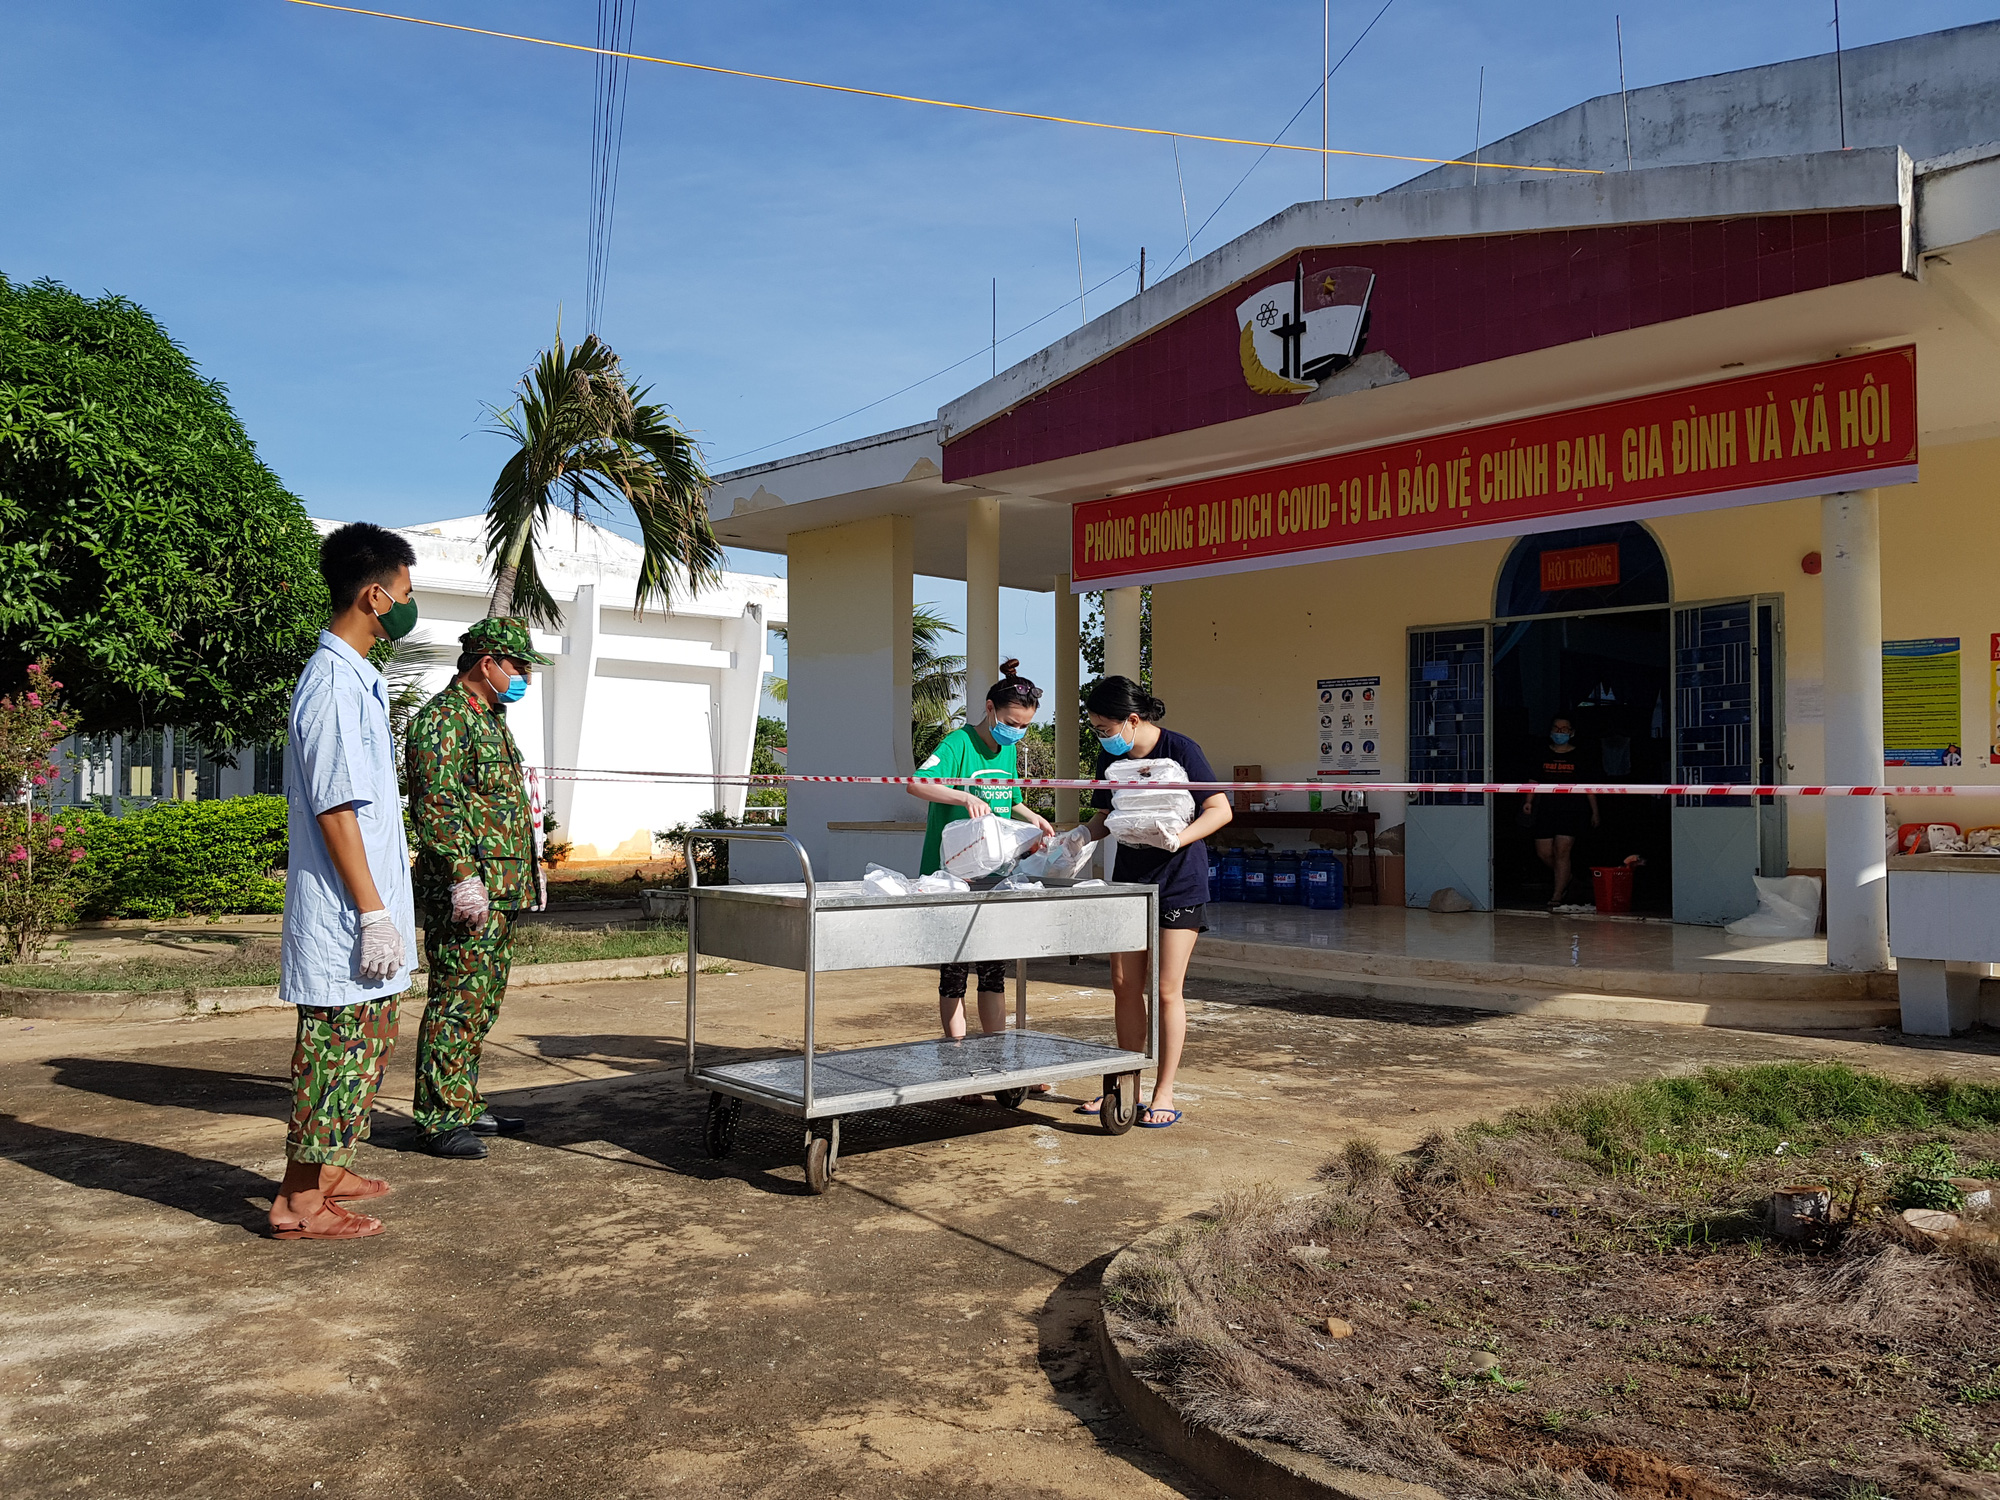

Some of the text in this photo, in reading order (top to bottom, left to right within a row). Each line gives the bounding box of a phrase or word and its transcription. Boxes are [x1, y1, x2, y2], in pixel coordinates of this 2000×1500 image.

[1085, 373, 1891, 563] PHÒNG CHỐNG ĐẠI DỊCH COVID-19 LÀ BẢO VỆ CHÍNH BẠN, GIA ĐÌNH VÀ XÃ HỘI
[1547, 551, 1612, 585] HỘI TRƯỜNG
